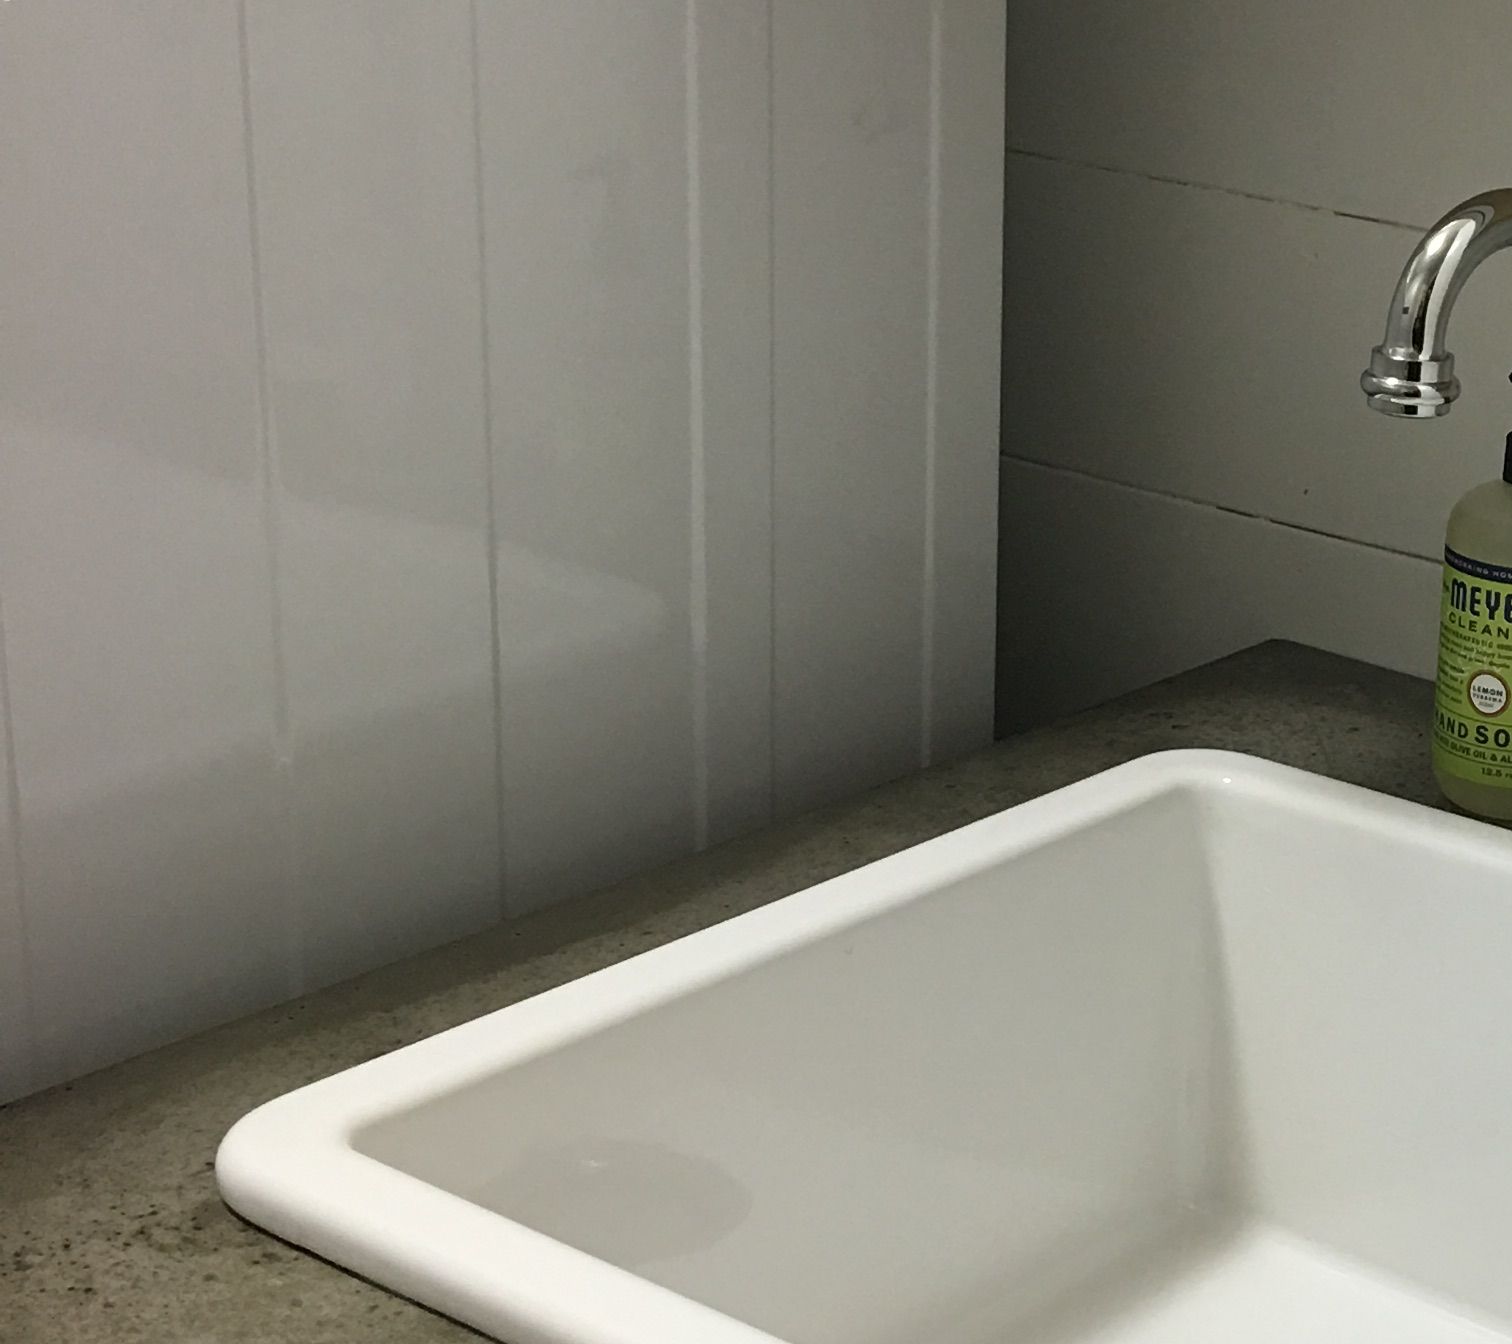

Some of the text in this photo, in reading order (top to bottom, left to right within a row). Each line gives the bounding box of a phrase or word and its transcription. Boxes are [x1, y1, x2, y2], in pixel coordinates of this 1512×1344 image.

[1448, 611, 1510, 640] CLEAN
[1472, 685, 1503, 697] LEMON
[1473, 749, 1488, 760] OIL
[1490, 753, 1498, 762] &
